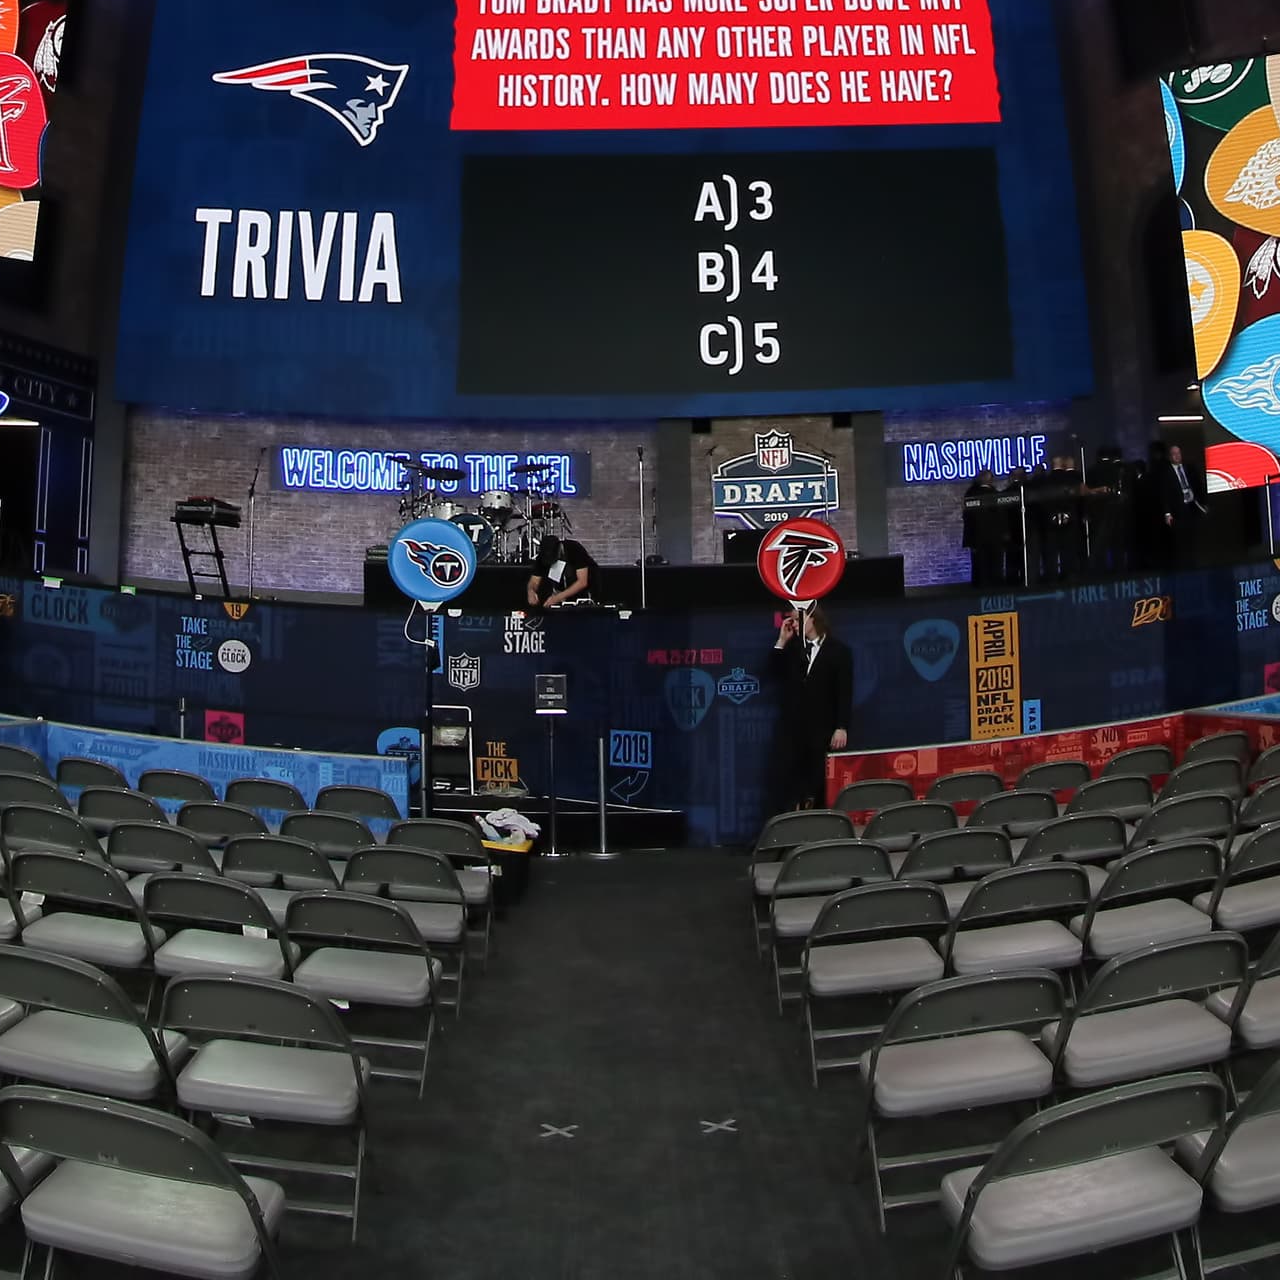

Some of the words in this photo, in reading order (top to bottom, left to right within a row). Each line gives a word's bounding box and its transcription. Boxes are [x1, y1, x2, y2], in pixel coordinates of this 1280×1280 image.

[472, 29, 569, 59] AWARDS
[582, 28, 645, 58] THAN
[657, 27, 705, 58] ANY
[717, 27, 792, 57] OTHER
[803, 26, 890, 56] PLAYER
[900, 25, 923, 55] IN
[933, 25, 976, 54] NFL
[499, 75, 608, 106] HISTORY.
[622, 74, 676, 105] HOW
[689, 73, 757, 104] MANY
[770, 72, 830, 103] DOES
[841, 71, 870, 102] HE
[881, 70, 952, 101] HAVE?
[694, 175, 738, 231] A)
[749, 181, 774, 221] 3
[196, 209, 401, 302] TRIVIA
[698, 245, 741, 303] B)
[752, 252, 778, 292] 4
[700, 316, 742, 375] C)
[755, 324, 780, 364] 5
[11, 376, 61, 406] CITY
[760, 449, 789, 469] NFL
[903, 434, 1048, 483] NASHVILLE
[281, 447, 410, 491] WELCOME
[421, 452, 459, 493] TO
[464, 453, 519, 494] THE
[526, 454, 577, 495] NFL
[723, 478, 827, 505] DRAFT
[763, 511, 790, 523] 2019
[1239, 577, 1263, 596] TAKE
[31, 595, 90, 625] CLOCK
[230, 603, 241, 617] 19
[1236, 598, 1250, 614] THE
[181, 615, 209, 635] TAKE
[504, 616, 525, 631] THE
[1236, 609, 1269, 632] STAGE
[176, 634, 192, 650] THE
[503, 631, 546, 654] STAGE
[982, 619, 1005, 663] APRIL
[175, 649, 214, 672] STAGE
[220, 649, 249, 665] CLOCK
[450, 668, 477, 685] NFL
[977, 667, 1014, 691] 2019
[721, 683, 757, 693] DRAFT
[977, 693, 1014, 705] NFL
[977, 704, 1015, 715] DRAFT
[977, 713, 1015, 726] PICK
[486, 741, 507, 757] THE
[613, 733, 650, 765] 2019
[198, 751, 258, 772] NASHVILLE
[480, 760, 514, 780] PICK
